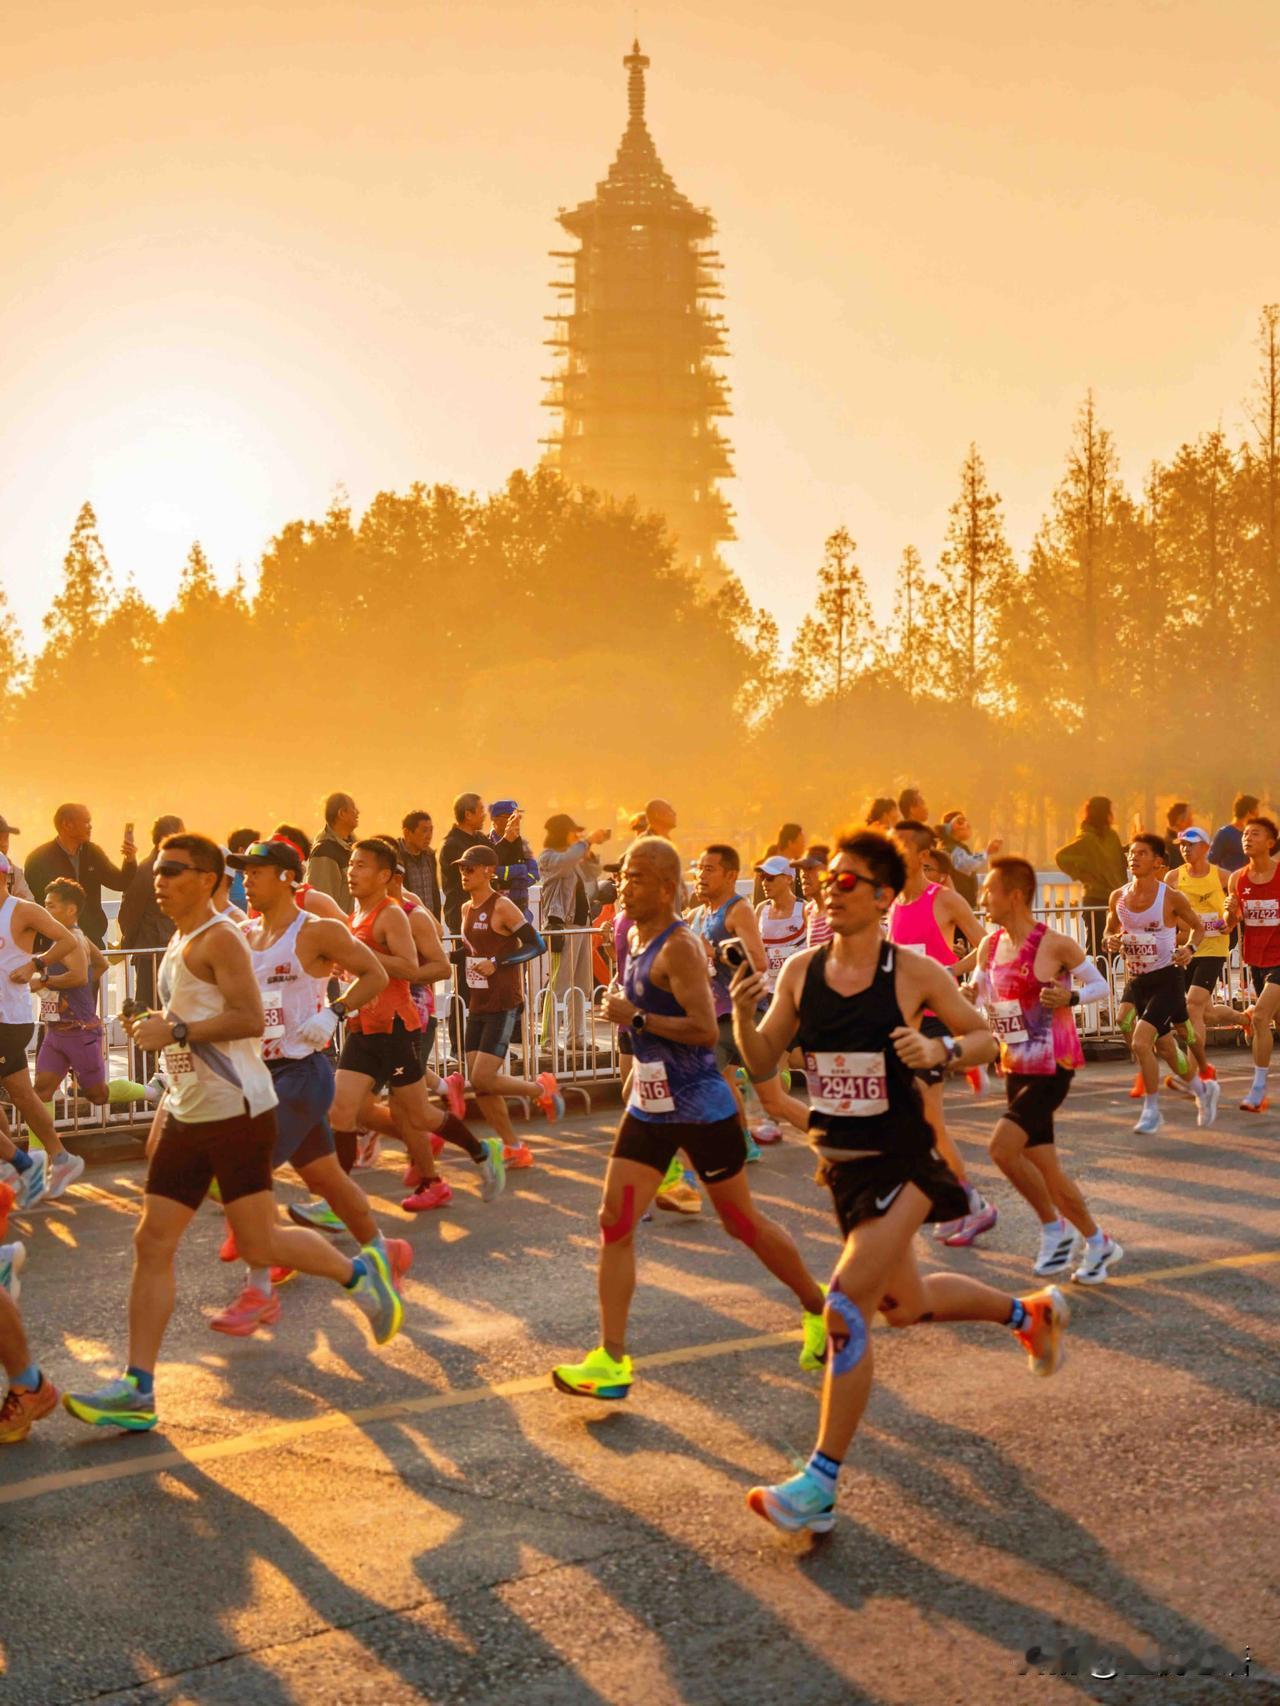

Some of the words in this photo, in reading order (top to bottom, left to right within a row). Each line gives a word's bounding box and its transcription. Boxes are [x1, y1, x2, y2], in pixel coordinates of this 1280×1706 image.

[1250, 910, 1277, 919] 27422
[1126, 945, 1153, 955] 21204
[822, 1077, 880, 1099] 29416
